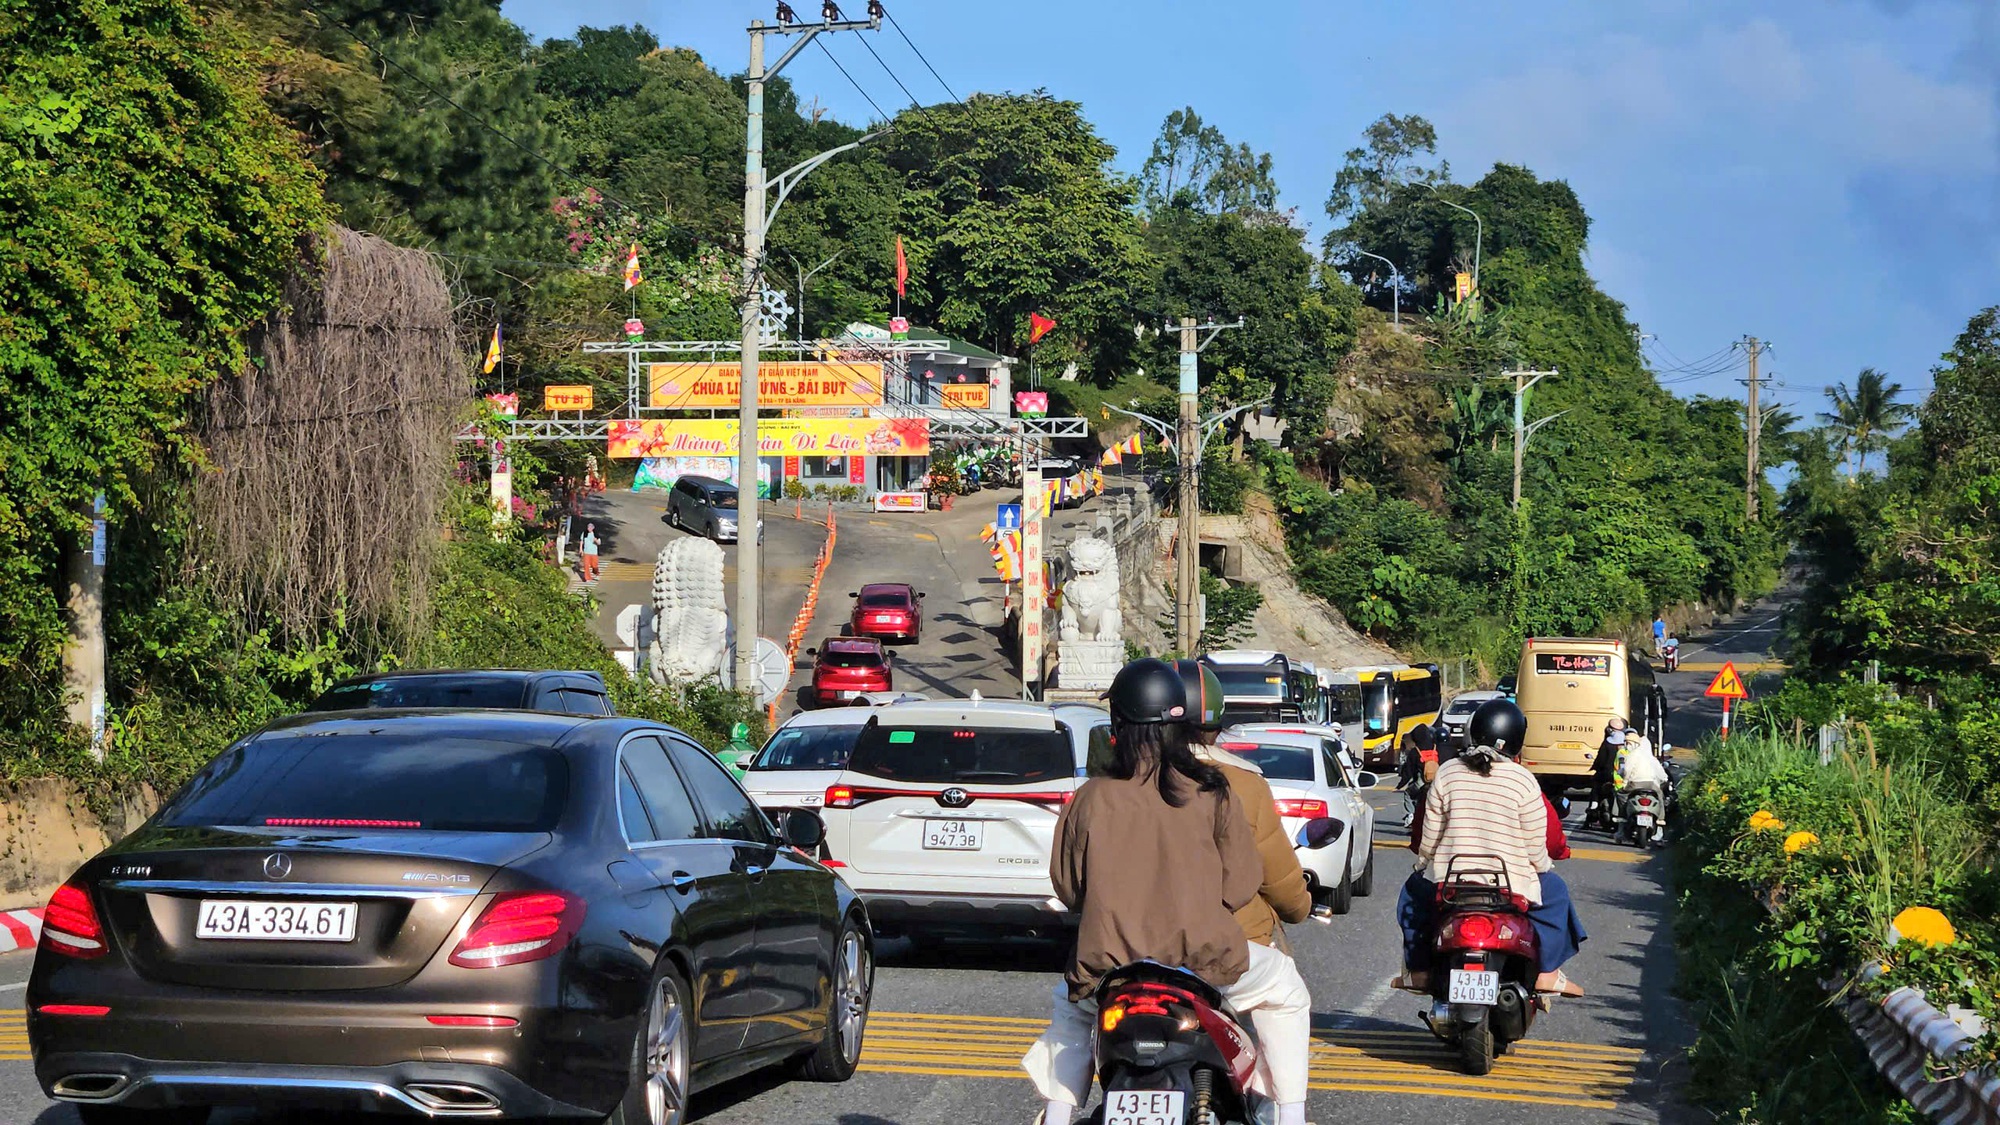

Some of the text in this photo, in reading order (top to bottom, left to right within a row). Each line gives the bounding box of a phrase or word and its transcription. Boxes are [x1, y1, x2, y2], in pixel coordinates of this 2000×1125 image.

[802, 368, 818, 377] NAM
[692, 379, 724, 395] CHÙA
[822, 381, 847, 397] BỤT
[941, 821, 966, 834] 43A
[930, 834, 976, 846] 947.38
[998, 857, 1040, 865] CROSS
[424, 873, 471, 883] AMG
[204, 904, 347, 936] 43A-334.61
[1457, 973, 1491, 987] 43-AB
[1452, 987, 1494, 1001] 340.39
[1116, 1093, 1171, 1115] 43-E1
